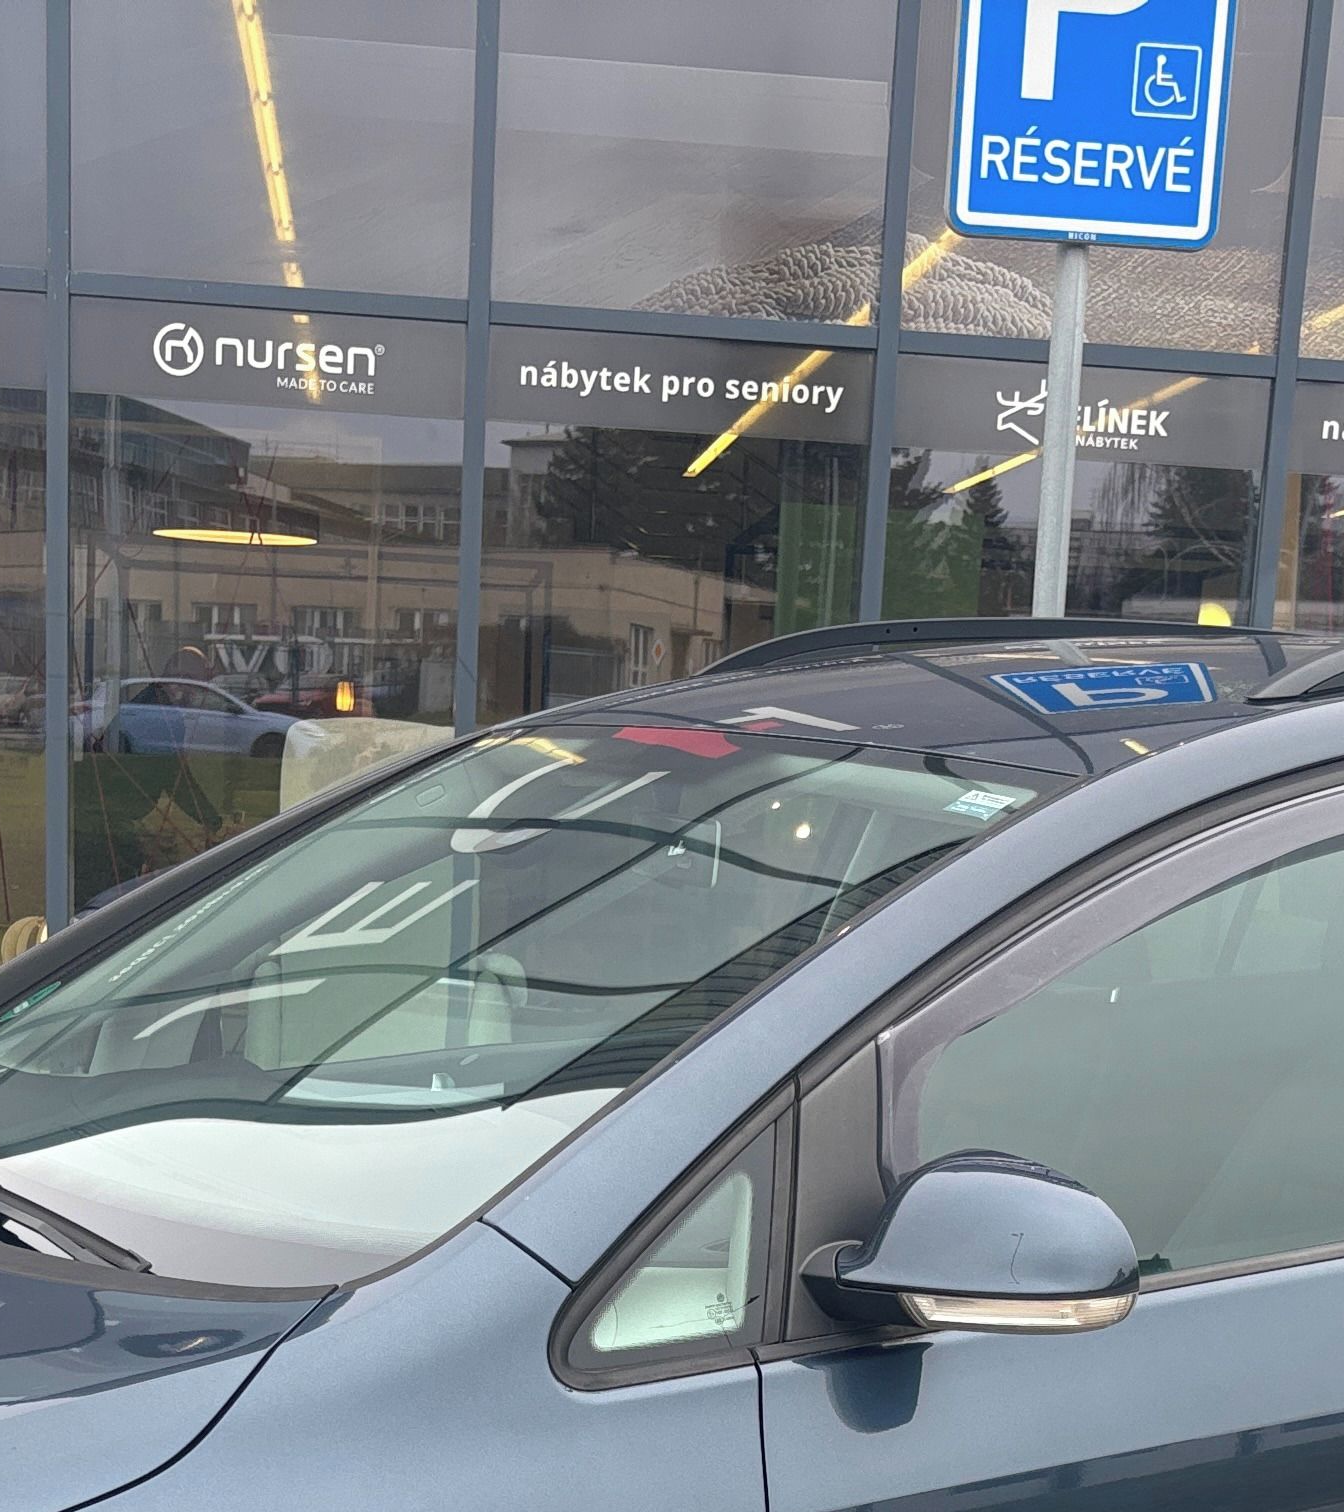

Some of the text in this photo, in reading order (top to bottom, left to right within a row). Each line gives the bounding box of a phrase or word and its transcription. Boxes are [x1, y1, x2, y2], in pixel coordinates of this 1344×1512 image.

[979, 125, 1195, 193] RÉSERVÉ
[215, 337, 376, 377] nursen
[276, 376, 375, 395] MADE TO CARE
[520, 360, 845, 413] nábytek pro seniory
[1077, 398, 1170, 437] LÍNEK
[1075, 433, 1139, 450] NÁBYTEK
